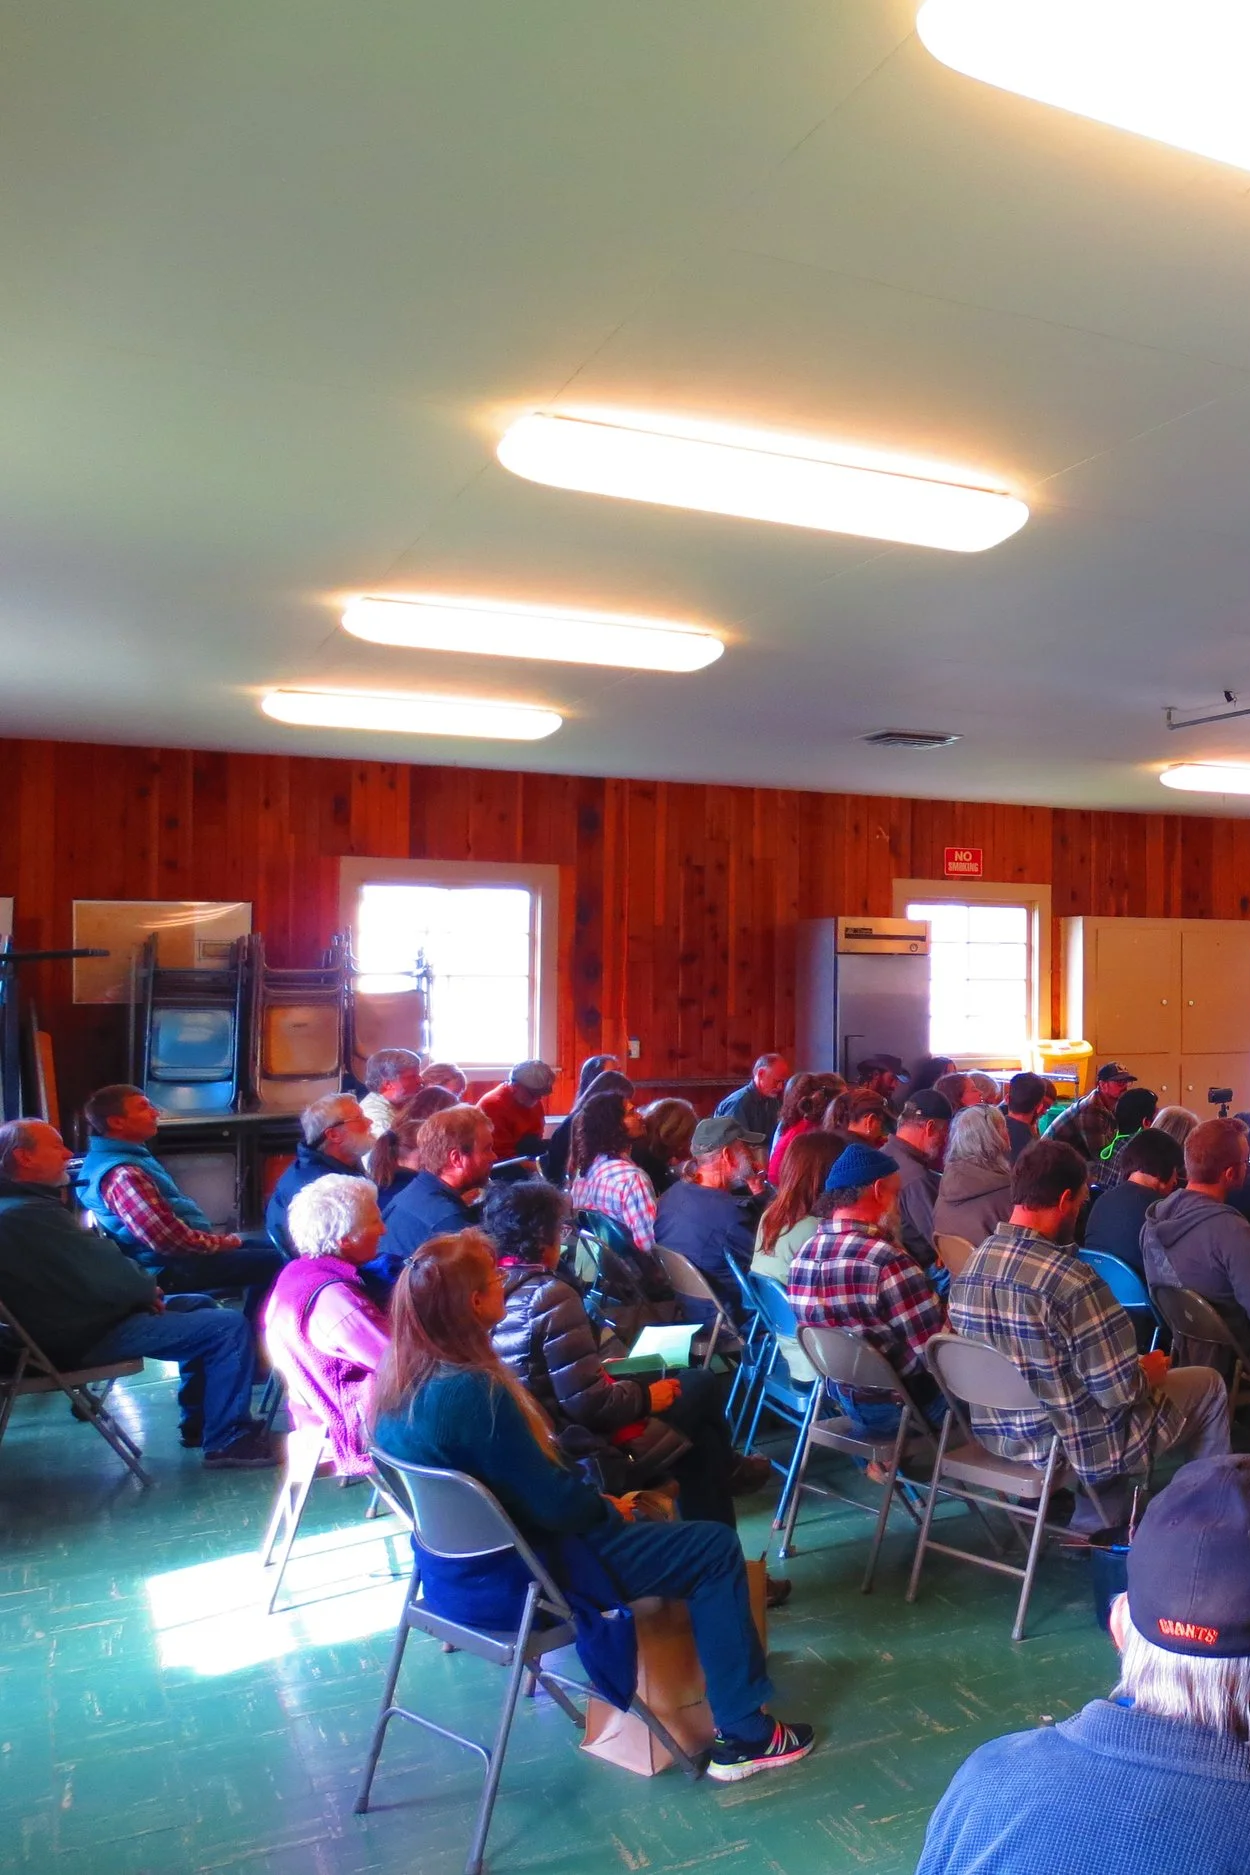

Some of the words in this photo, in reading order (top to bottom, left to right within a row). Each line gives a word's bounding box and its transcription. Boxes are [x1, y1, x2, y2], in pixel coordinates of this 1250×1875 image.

[954, 850, 972, 862] NO
[947, 861, 979, 873] SMOKING
[1158, 1618, 1219, 1645] GIANTS
